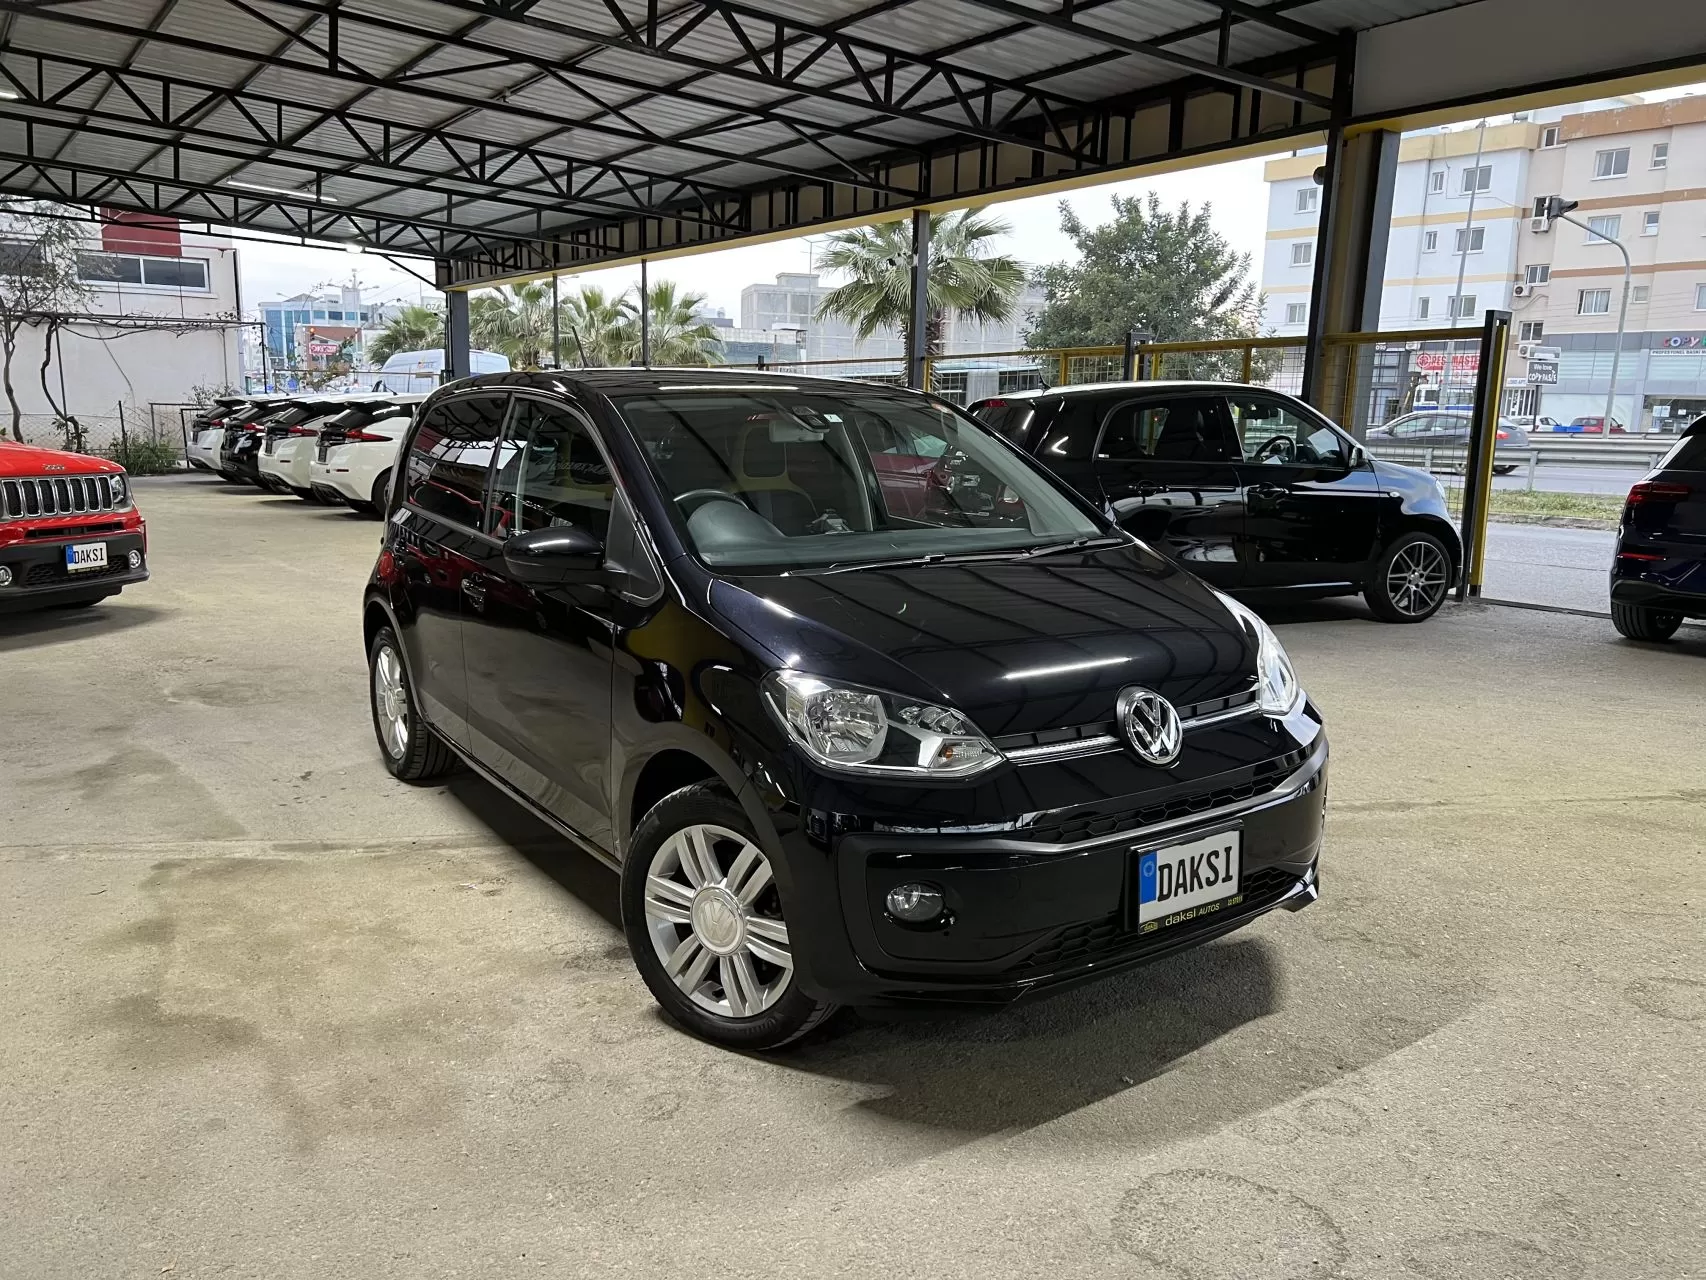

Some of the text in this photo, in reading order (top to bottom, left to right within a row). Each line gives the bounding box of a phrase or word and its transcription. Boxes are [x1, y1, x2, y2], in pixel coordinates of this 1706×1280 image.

[1663, 336, 1700, 347] COPY
[73, 547, 105, 564] DAKSI
[1157, 846, 1233, 902] DAKSI
[1198, 903, 1220, 916] AUTOS
